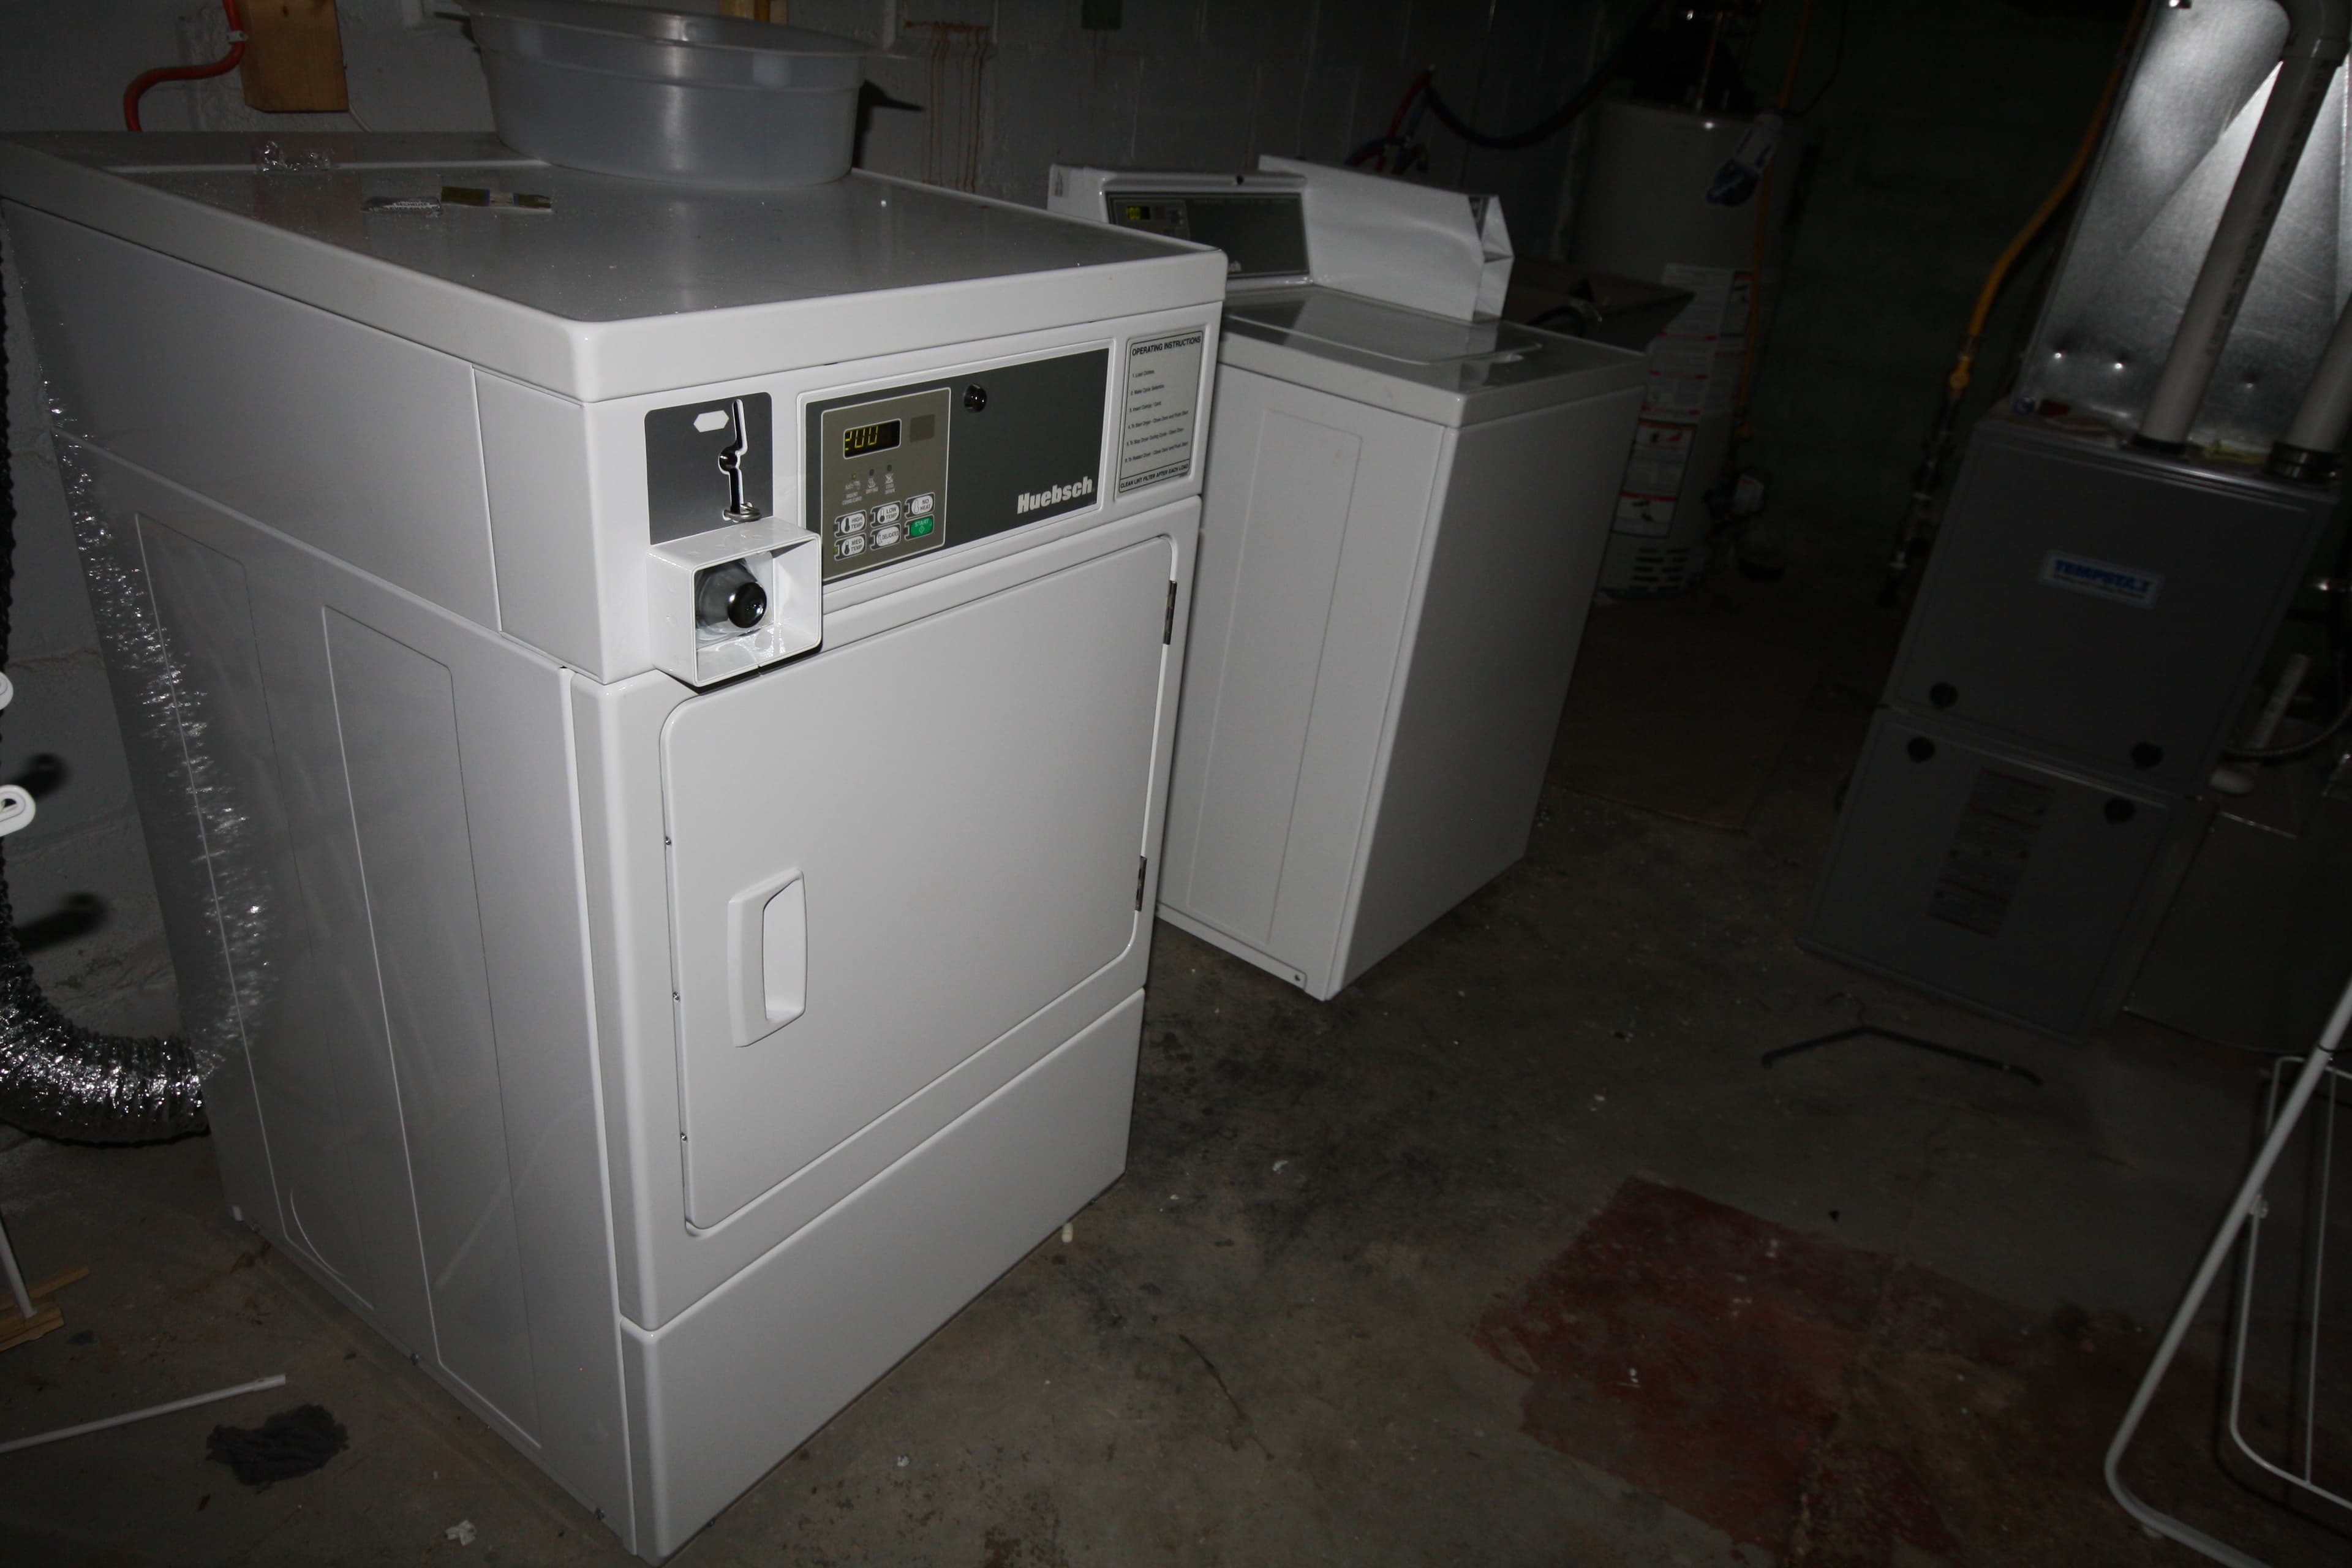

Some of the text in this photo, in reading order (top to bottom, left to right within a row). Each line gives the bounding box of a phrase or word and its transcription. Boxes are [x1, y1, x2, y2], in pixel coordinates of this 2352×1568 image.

[1132, 336, 1201, 356] OPERATING INSTRUCTIONS
[1143, 473, 1156, 482] FILTER
[1017, 476, 1093, 514] Huebsch
[914, 518, 929, 527] START
